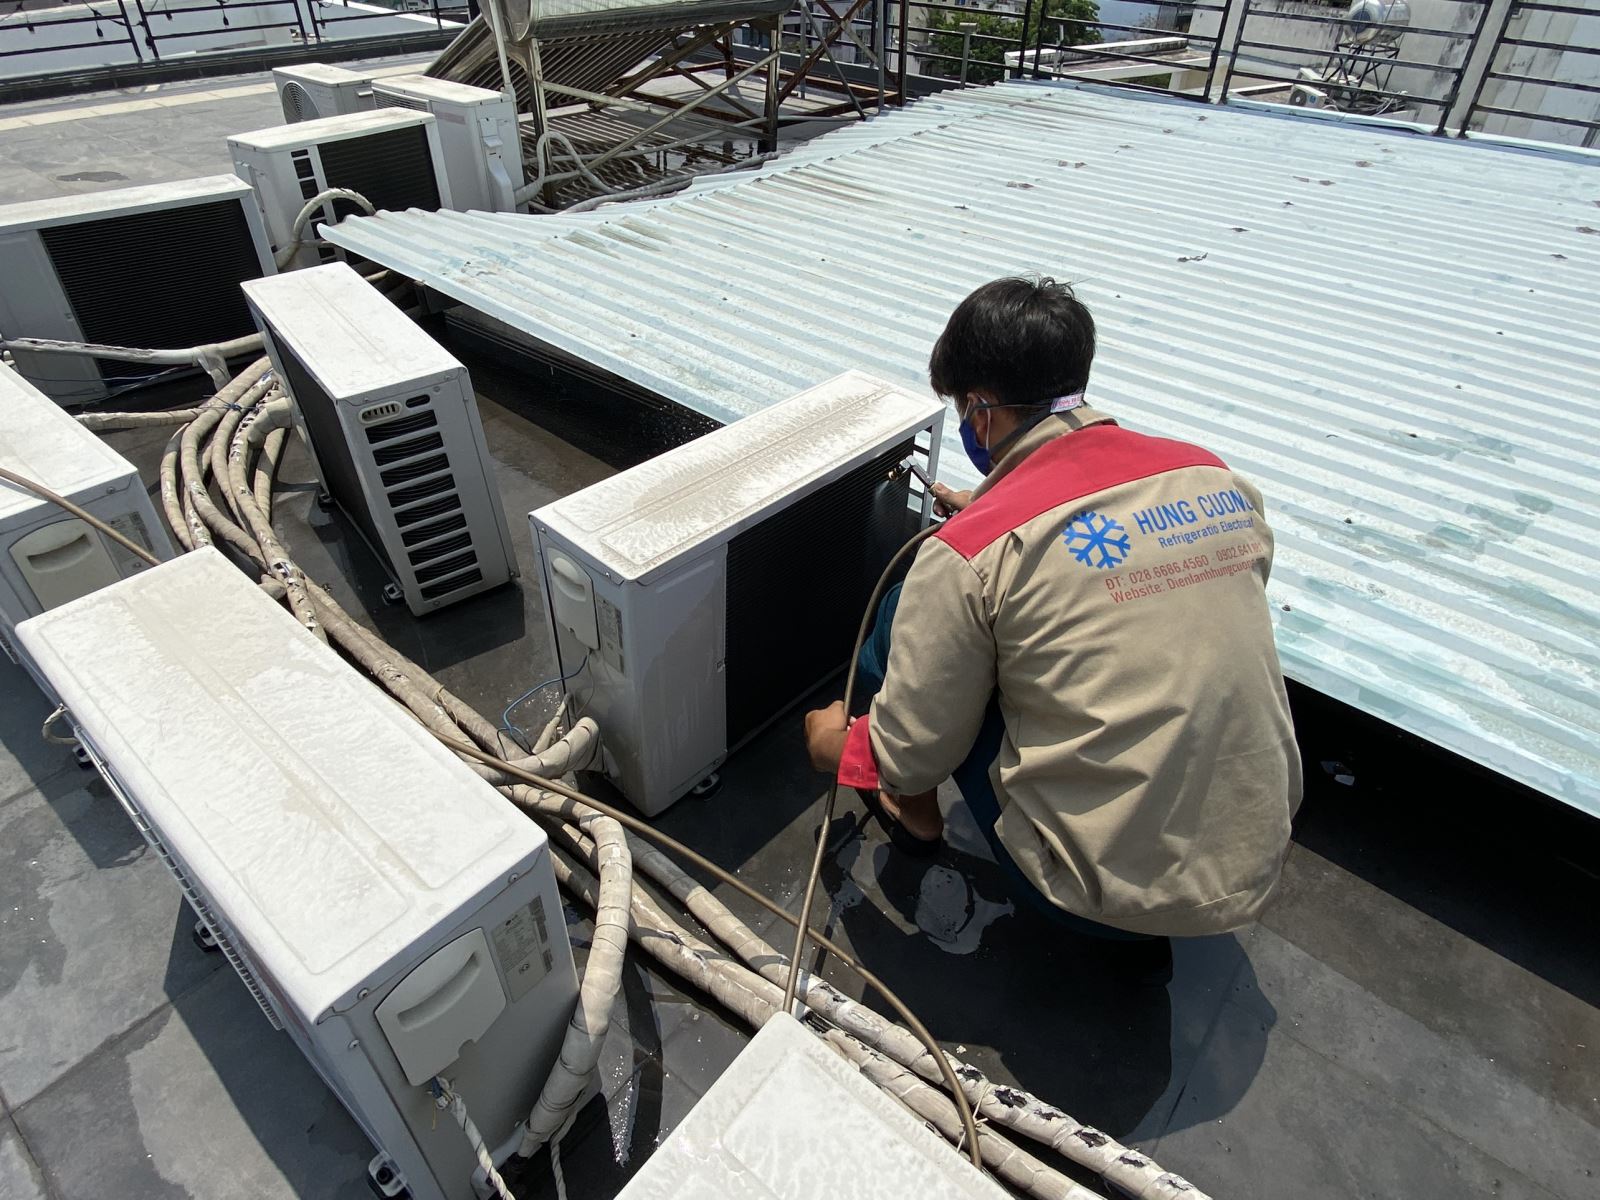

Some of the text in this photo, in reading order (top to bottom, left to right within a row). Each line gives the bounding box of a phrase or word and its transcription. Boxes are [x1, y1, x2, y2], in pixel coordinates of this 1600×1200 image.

[1133, 500, 1198, 534] HUNG
[1158, 525, 1219, 548] Refrigeratio
[1129, 554, 1209, 585] 028.6686.4560
[1110, 583, 1164, 604] Website:
